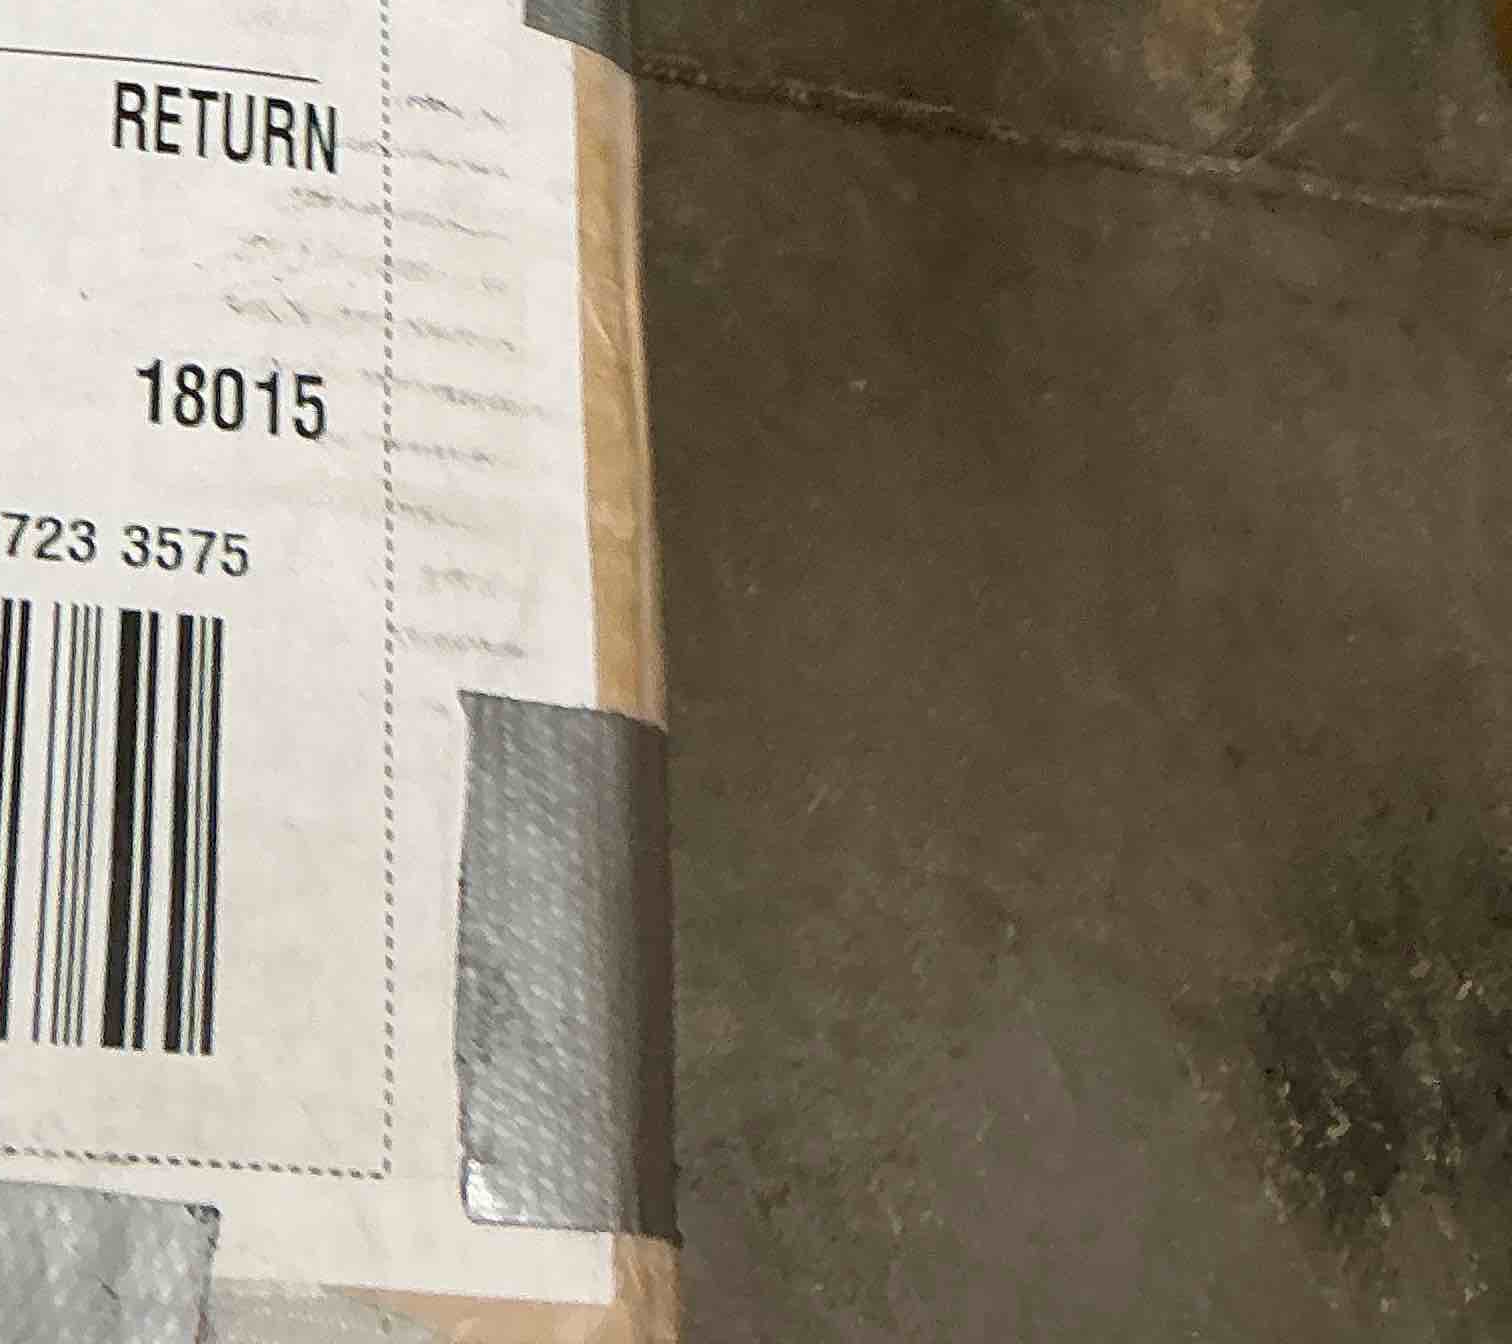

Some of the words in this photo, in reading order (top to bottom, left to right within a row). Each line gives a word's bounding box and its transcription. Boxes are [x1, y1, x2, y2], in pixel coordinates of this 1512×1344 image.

[111, 81, 338, 173] RETURN
[136, 358, 328, 441] 18015
[121, 524, 249, 578] 3575
